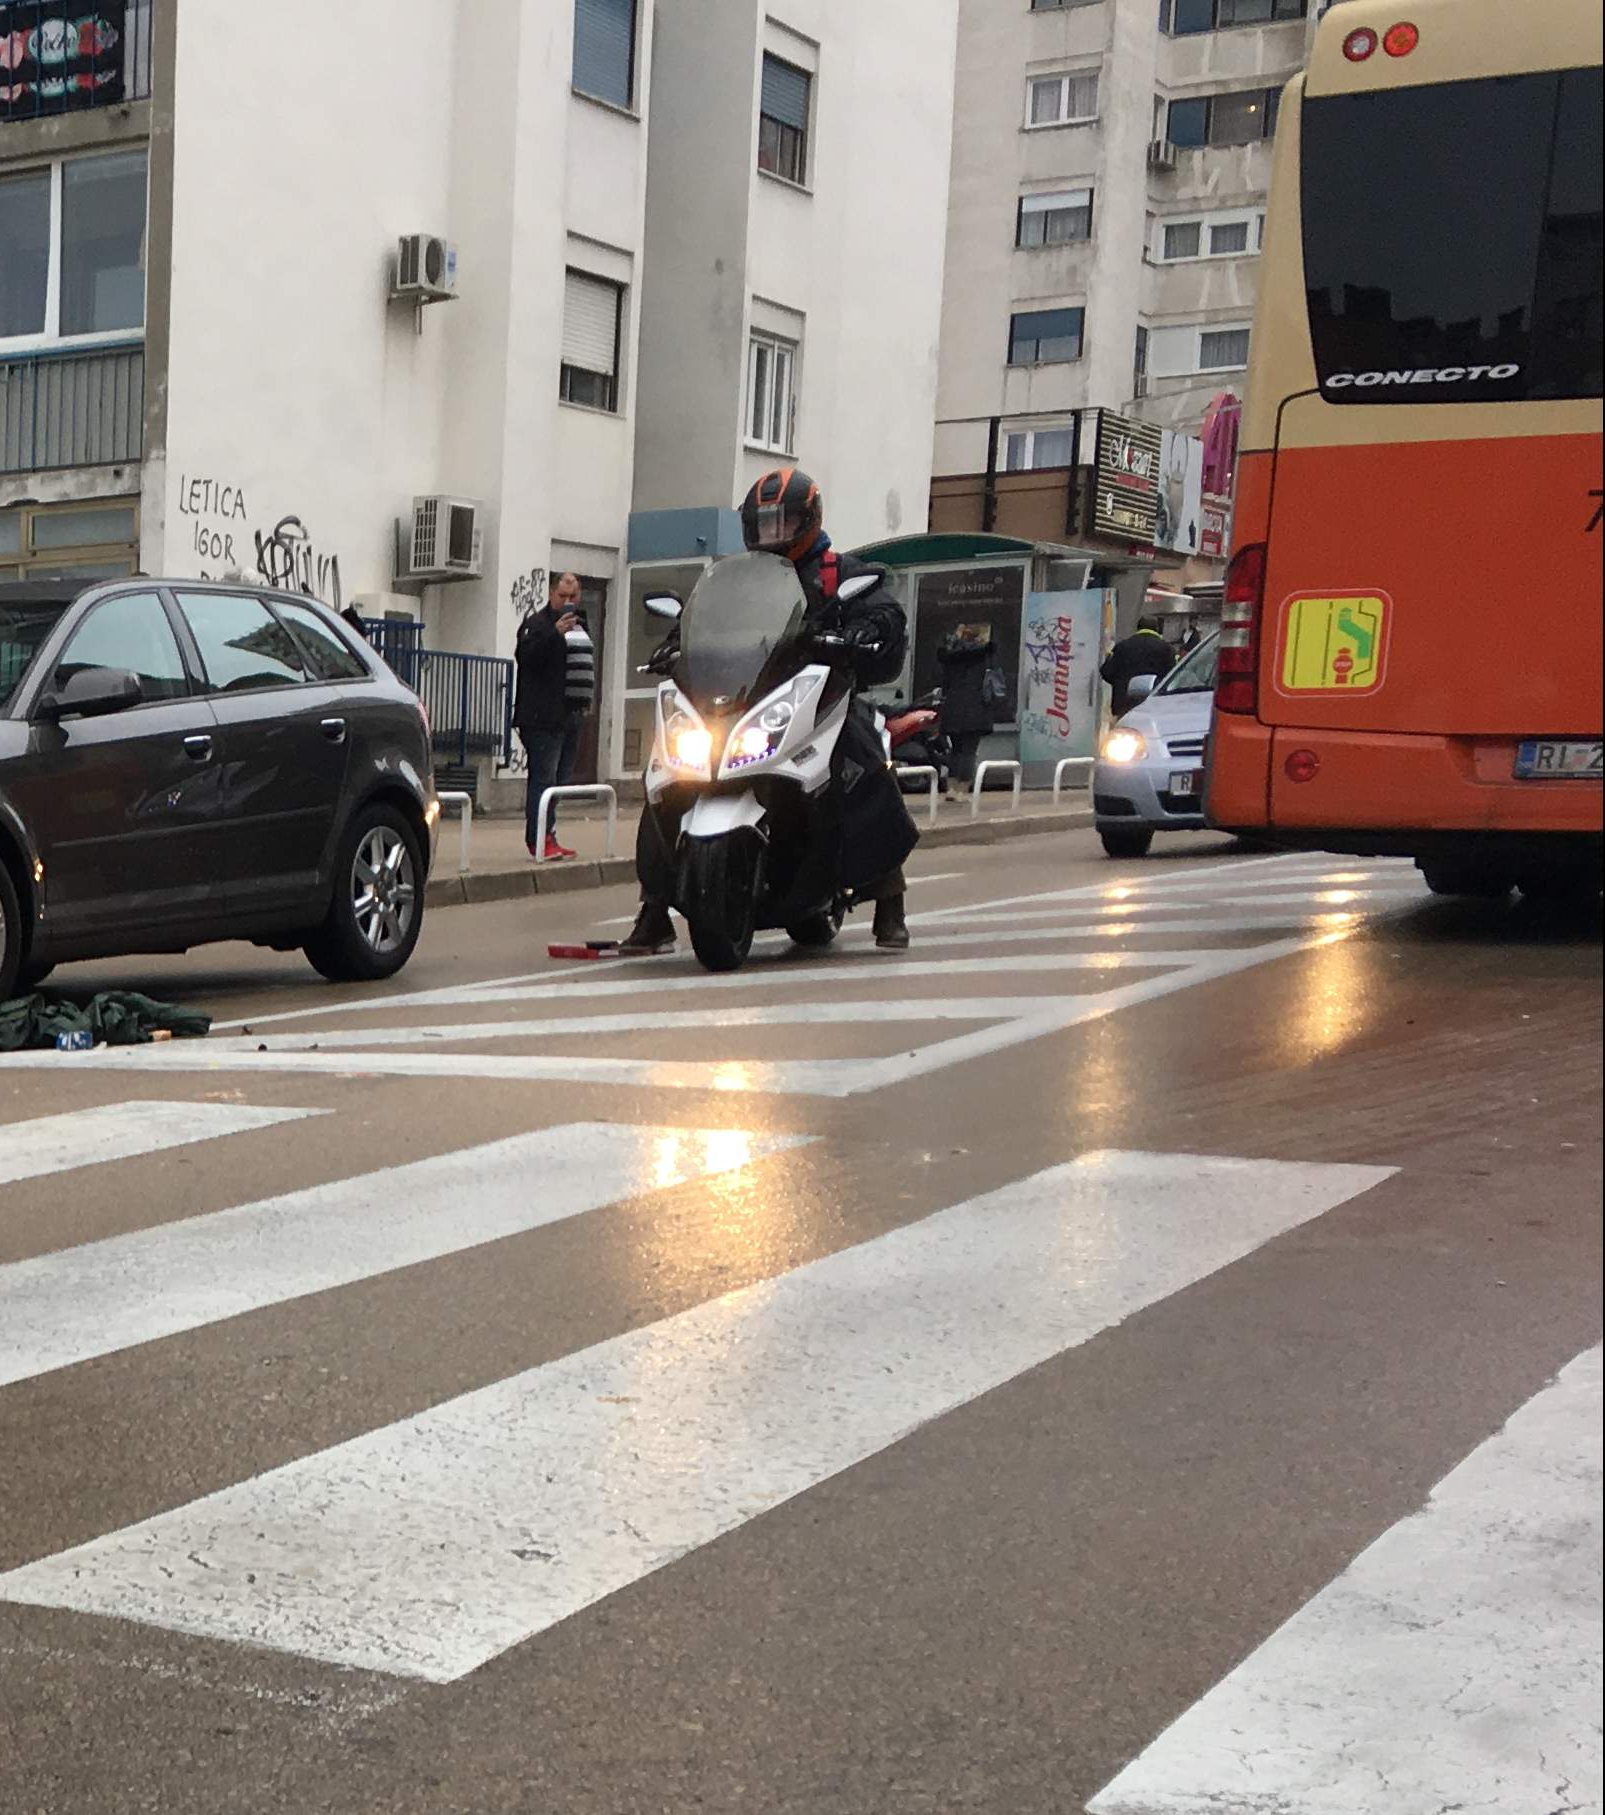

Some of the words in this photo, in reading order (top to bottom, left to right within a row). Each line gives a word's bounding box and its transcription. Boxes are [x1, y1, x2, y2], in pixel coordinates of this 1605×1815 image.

[1325, 363, 1520, 387] CONECTO
[179, 474, 246, 520] LETICA
[194, 520, 236, 566] IGOR
[1537, 745, 1567, 769] RI
